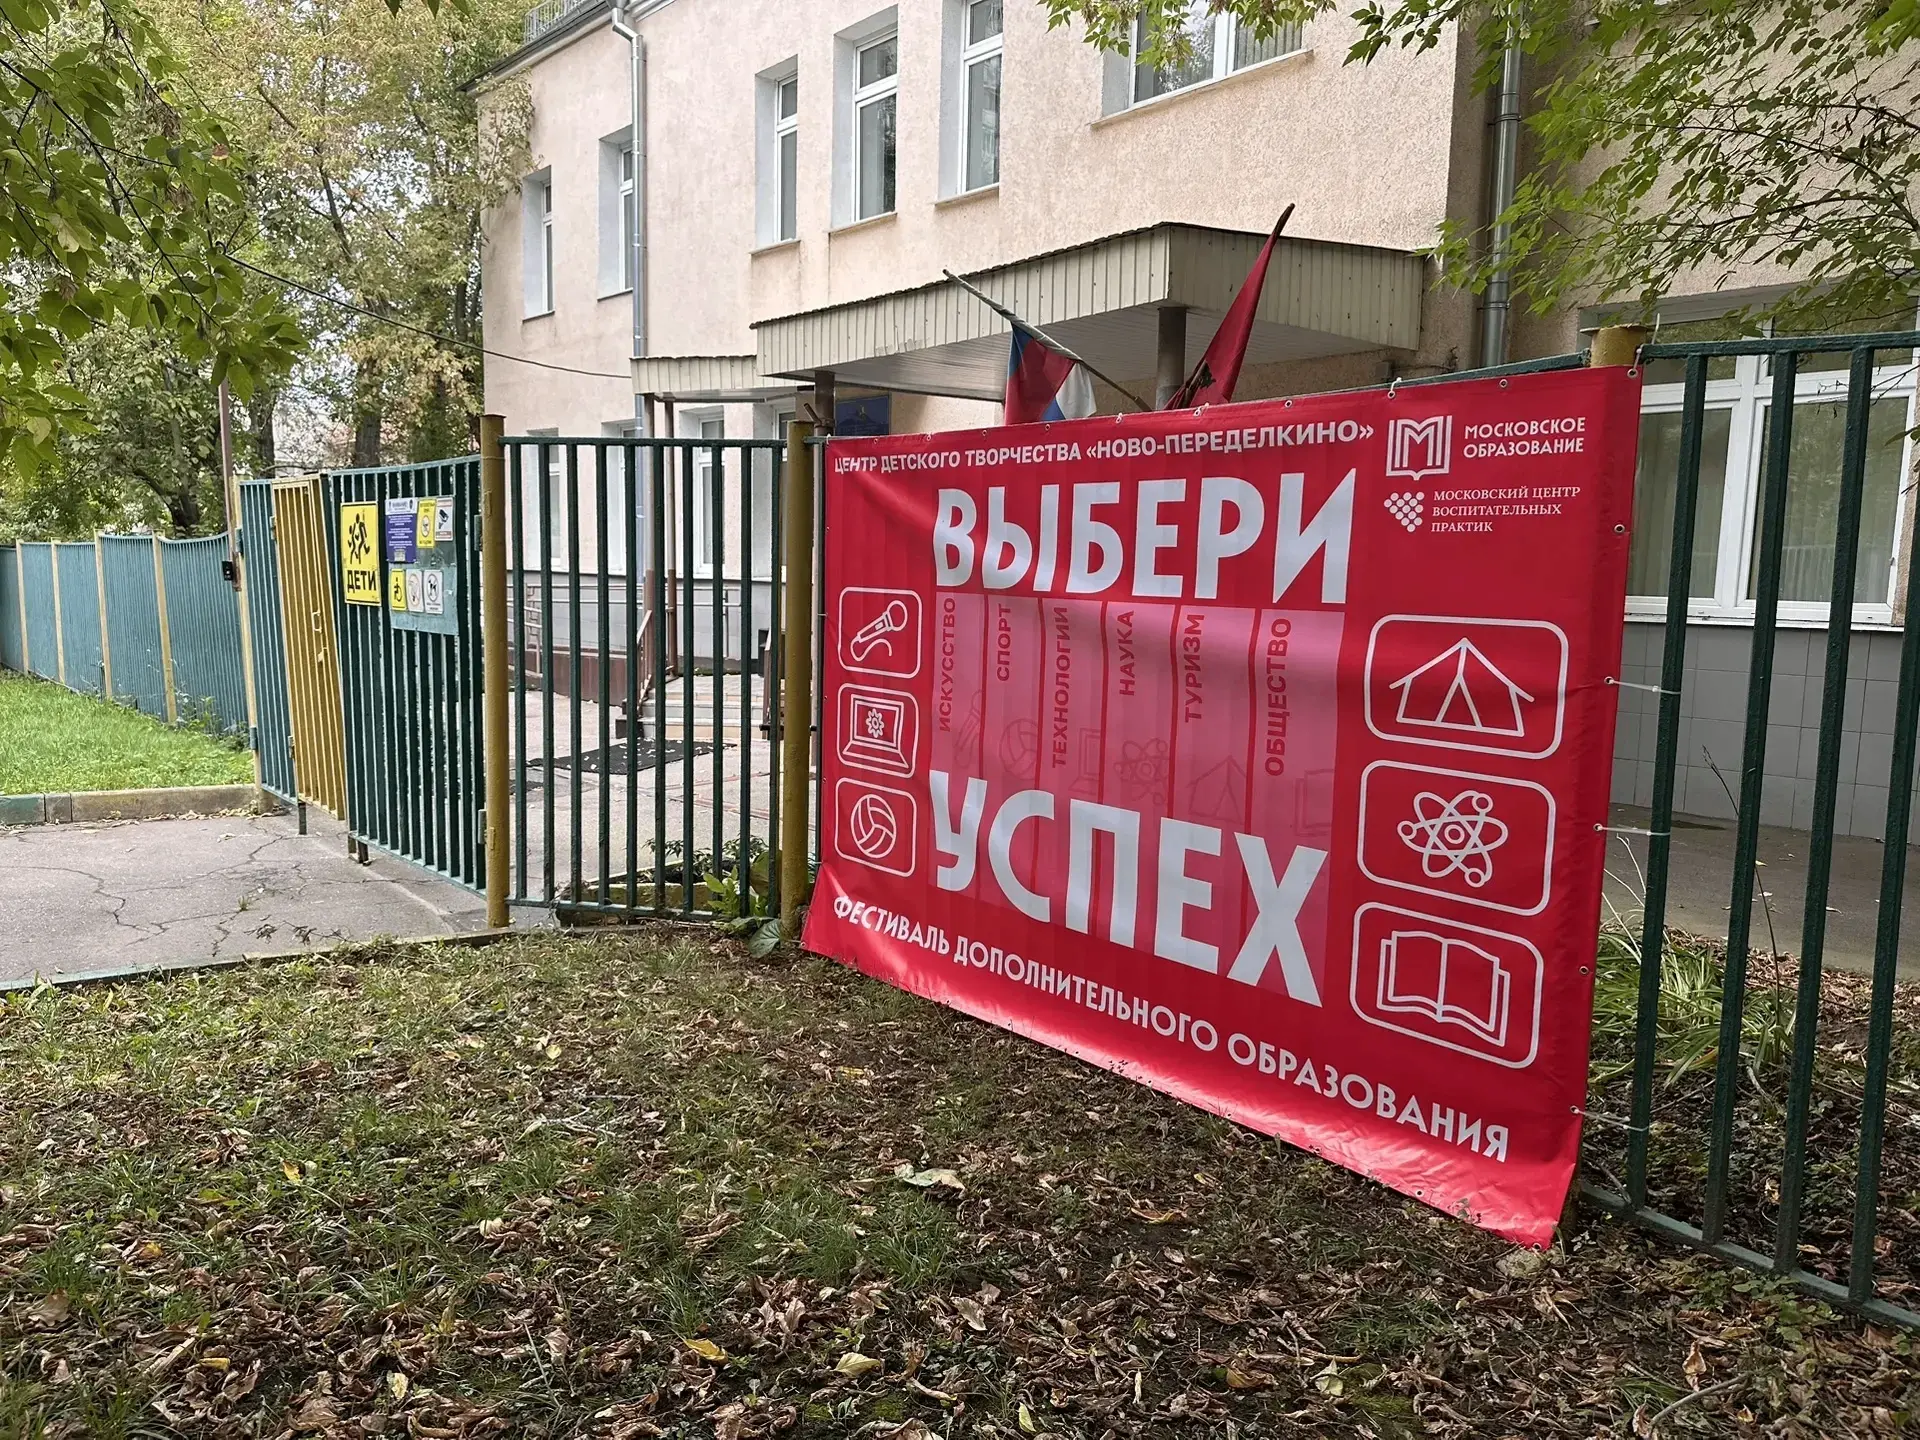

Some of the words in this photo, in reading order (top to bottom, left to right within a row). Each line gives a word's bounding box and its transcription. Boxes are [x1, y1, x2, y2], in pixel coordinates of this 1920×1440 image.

[834, 456, 878, 475] ЦЕНТР
[880, 452, 961, 473] ДЕТСКОГО
[965, 442, 1082, 467] ТВОРЧЕСТВА
[1086, 420, 1374, 459] «НОВО-ПЕРЕДЕЛКИНО»
[1463, 437, 1584, 459] ОБРАЗОВАНИЕ
[1464, 417, 1586, 440] МОСКОВСКОЕ
[1431, 521, 1493, 532] ПРАКТИК
[1432, 503, 1562, 517] ВОСПИТАТЕЛЬНЫХ
[1433, 486, 1528, 501] МОСКОВСКИЙ
[1531, 486, 1581, 500] ЦЕНТР
[932, 468, 1356, 604] ВЫБЕРИ
[347, 570, 377, 593] ДЕТИ
[939, 597, 956, 732] ИСКУССТВО
[996, 603, 1012, 682] СПОРТ
[1119, 610, 1135, 697] НАУКА
[1184, 613, 1205, 723] ТУРИЗМ
[1051, 606, 1072, 768] ТЕХНОЛОГИИ
[1265, 617, 1292, 777] ОБЩЕСТВО
[929, 769, 1328, 1008] УСПЕХ
[833, 895, 949, 955] ФЕСТИВАЛЬ
[953, 936, 1219, 1052] ДОПОЛНИТЕЛЬНОГО
[1227, 1032, 1509, 1163] ОБРАЗОВАНИЯ
